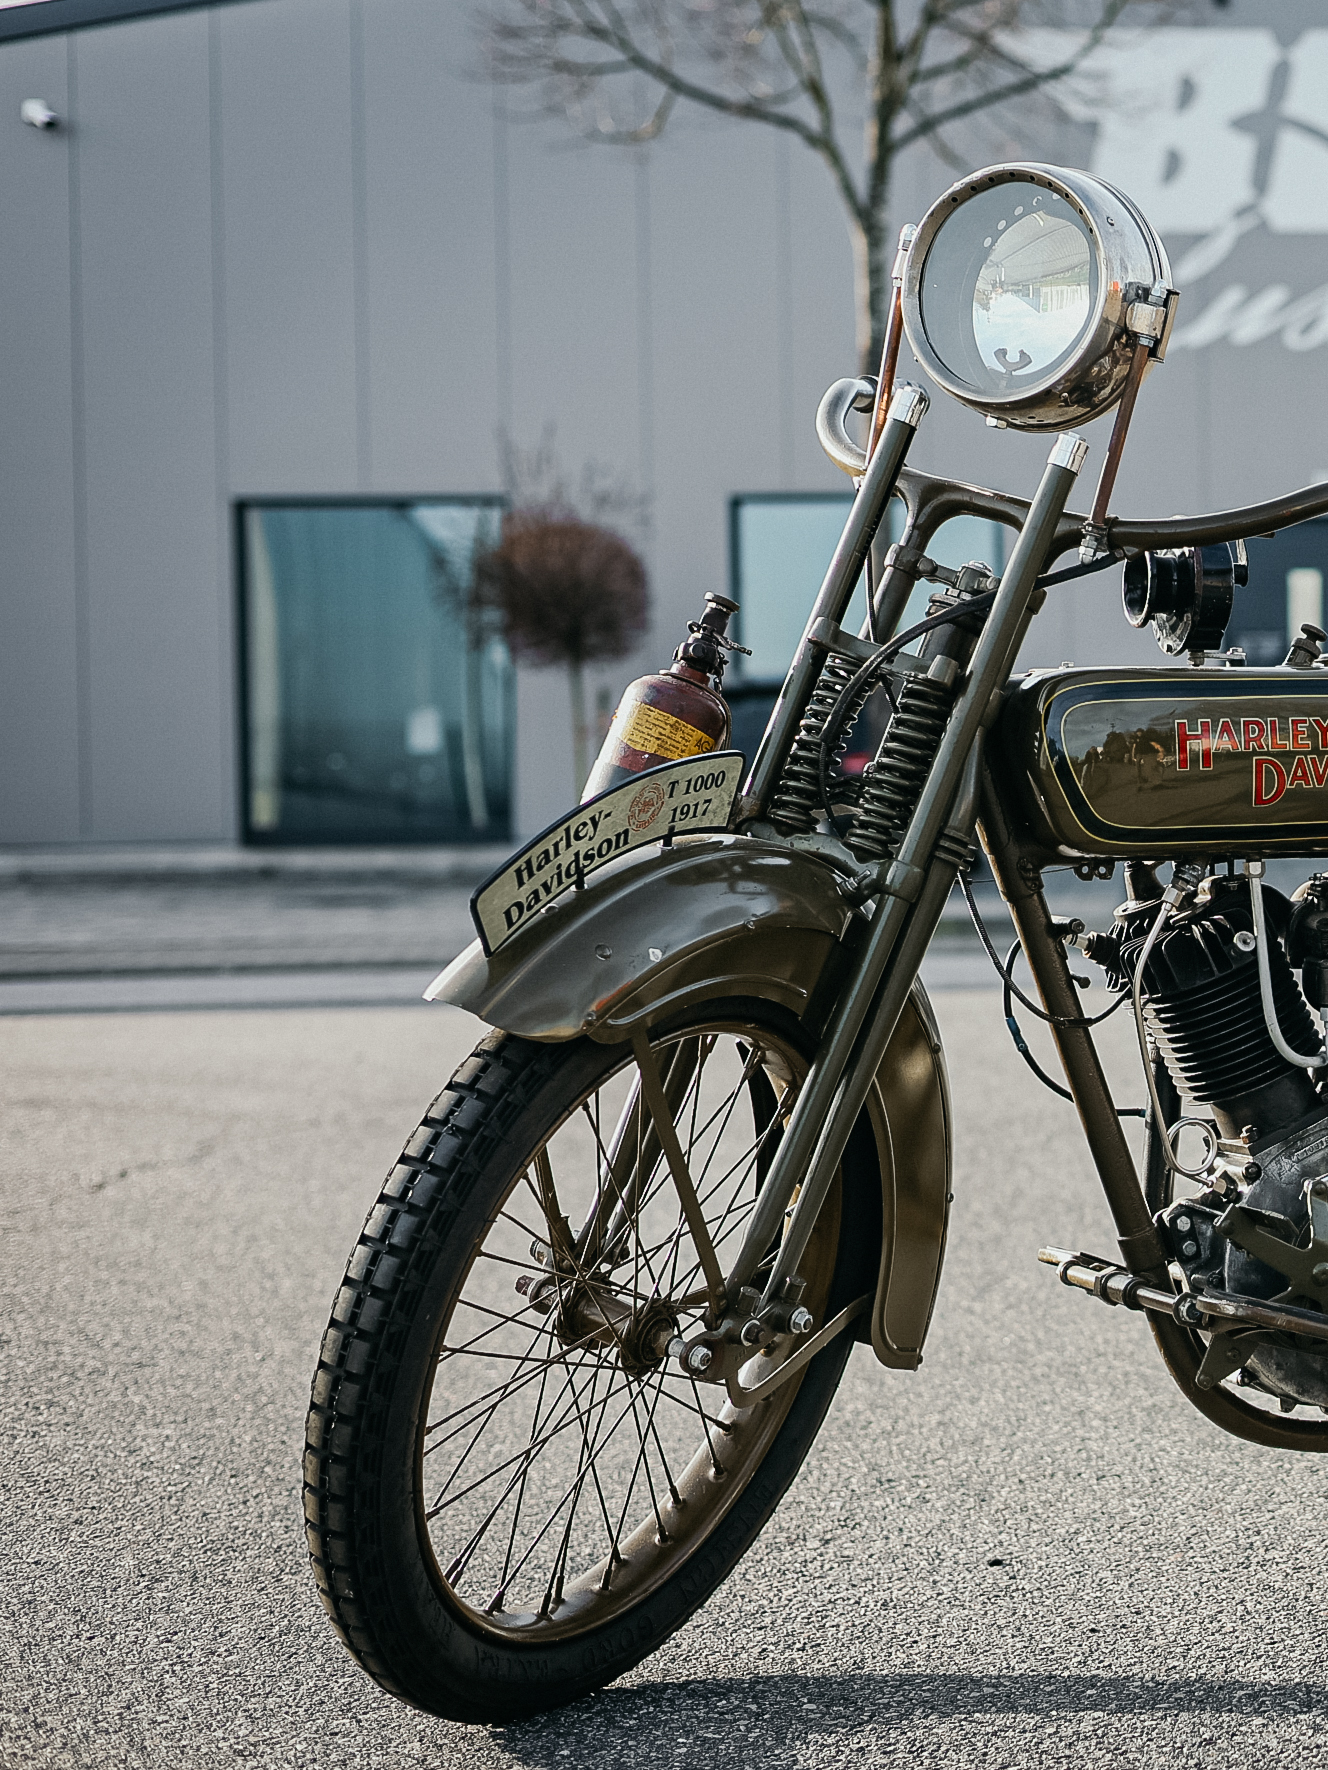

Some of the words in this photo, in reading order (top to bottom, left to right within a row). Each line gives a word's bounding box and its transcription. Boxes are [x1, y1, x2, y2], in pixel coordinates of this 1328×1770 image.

[667, 780, 680, 799] T
[682, 769, 726, 796] 1000
[668, 798, 713, 825] 1917
[512, 807, 613, 891] Harley-
[502, 827, 631, 932] Davidson
